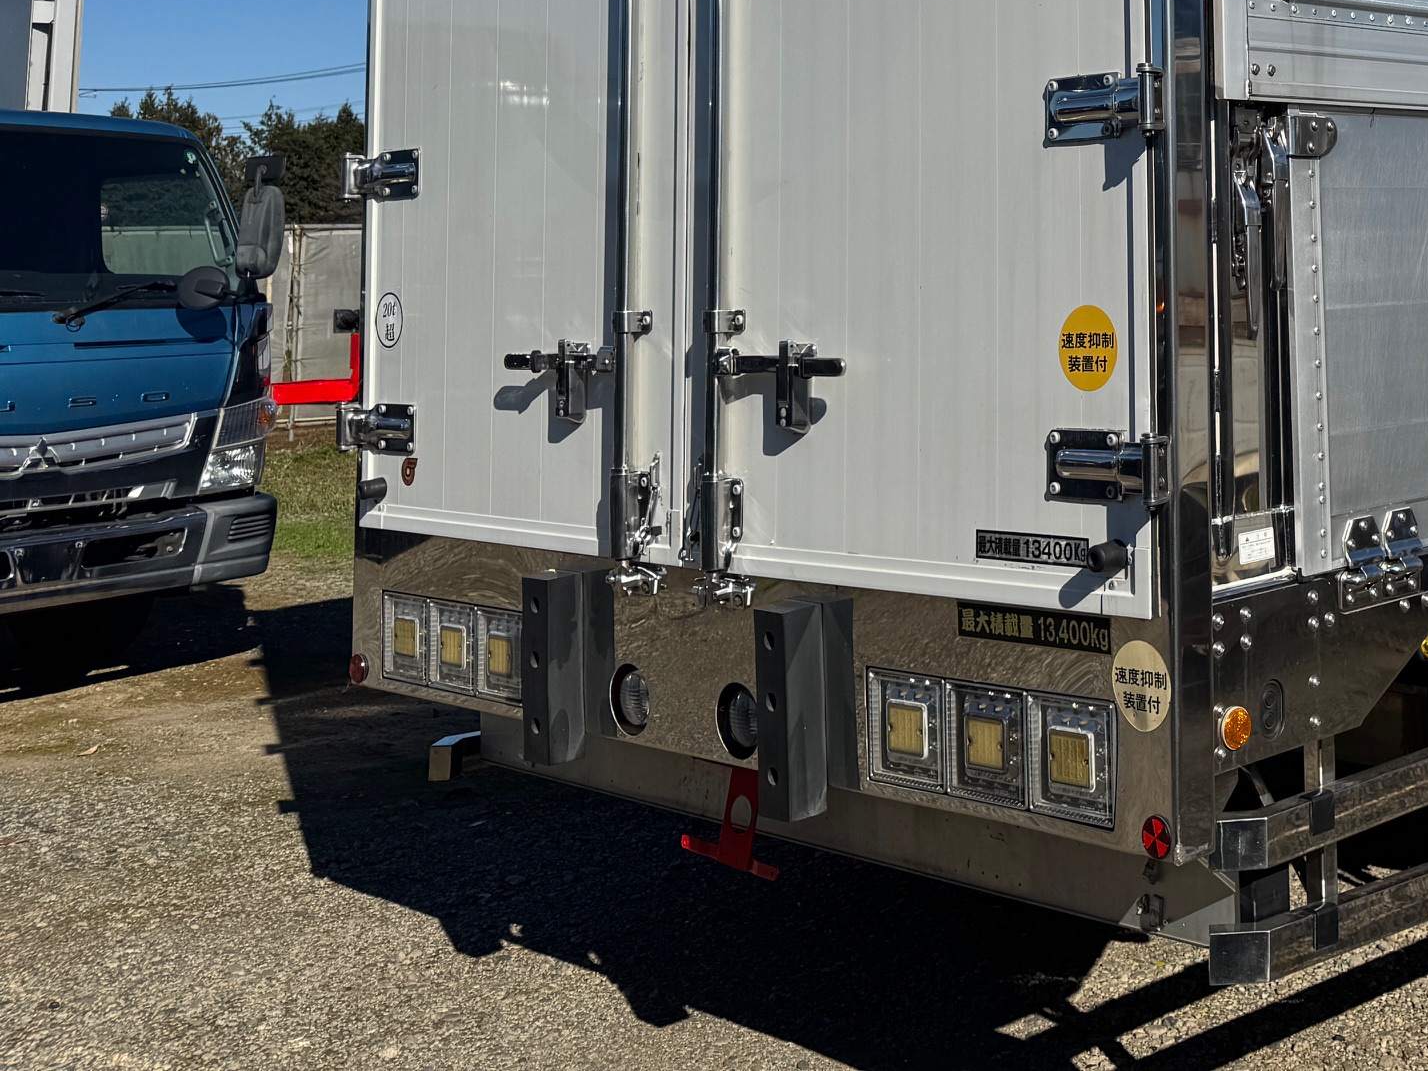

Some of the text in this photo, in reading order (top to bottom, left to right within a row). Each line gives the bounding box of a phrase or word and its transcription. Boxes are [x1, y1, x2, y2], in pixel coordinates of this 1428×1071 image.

[1061, 332, 1115, 350] 速度抑制
[1068, 355, 1108, 373] 装置付
[978, 534, 1087, 563] 最大積載量 13400Kg
[961, 608, 1109, 652] 最大積載量 13,400kg
[1114, 666, 1167, 691] 速度抑制
[1123, 690, 1161, 715] 装置付
